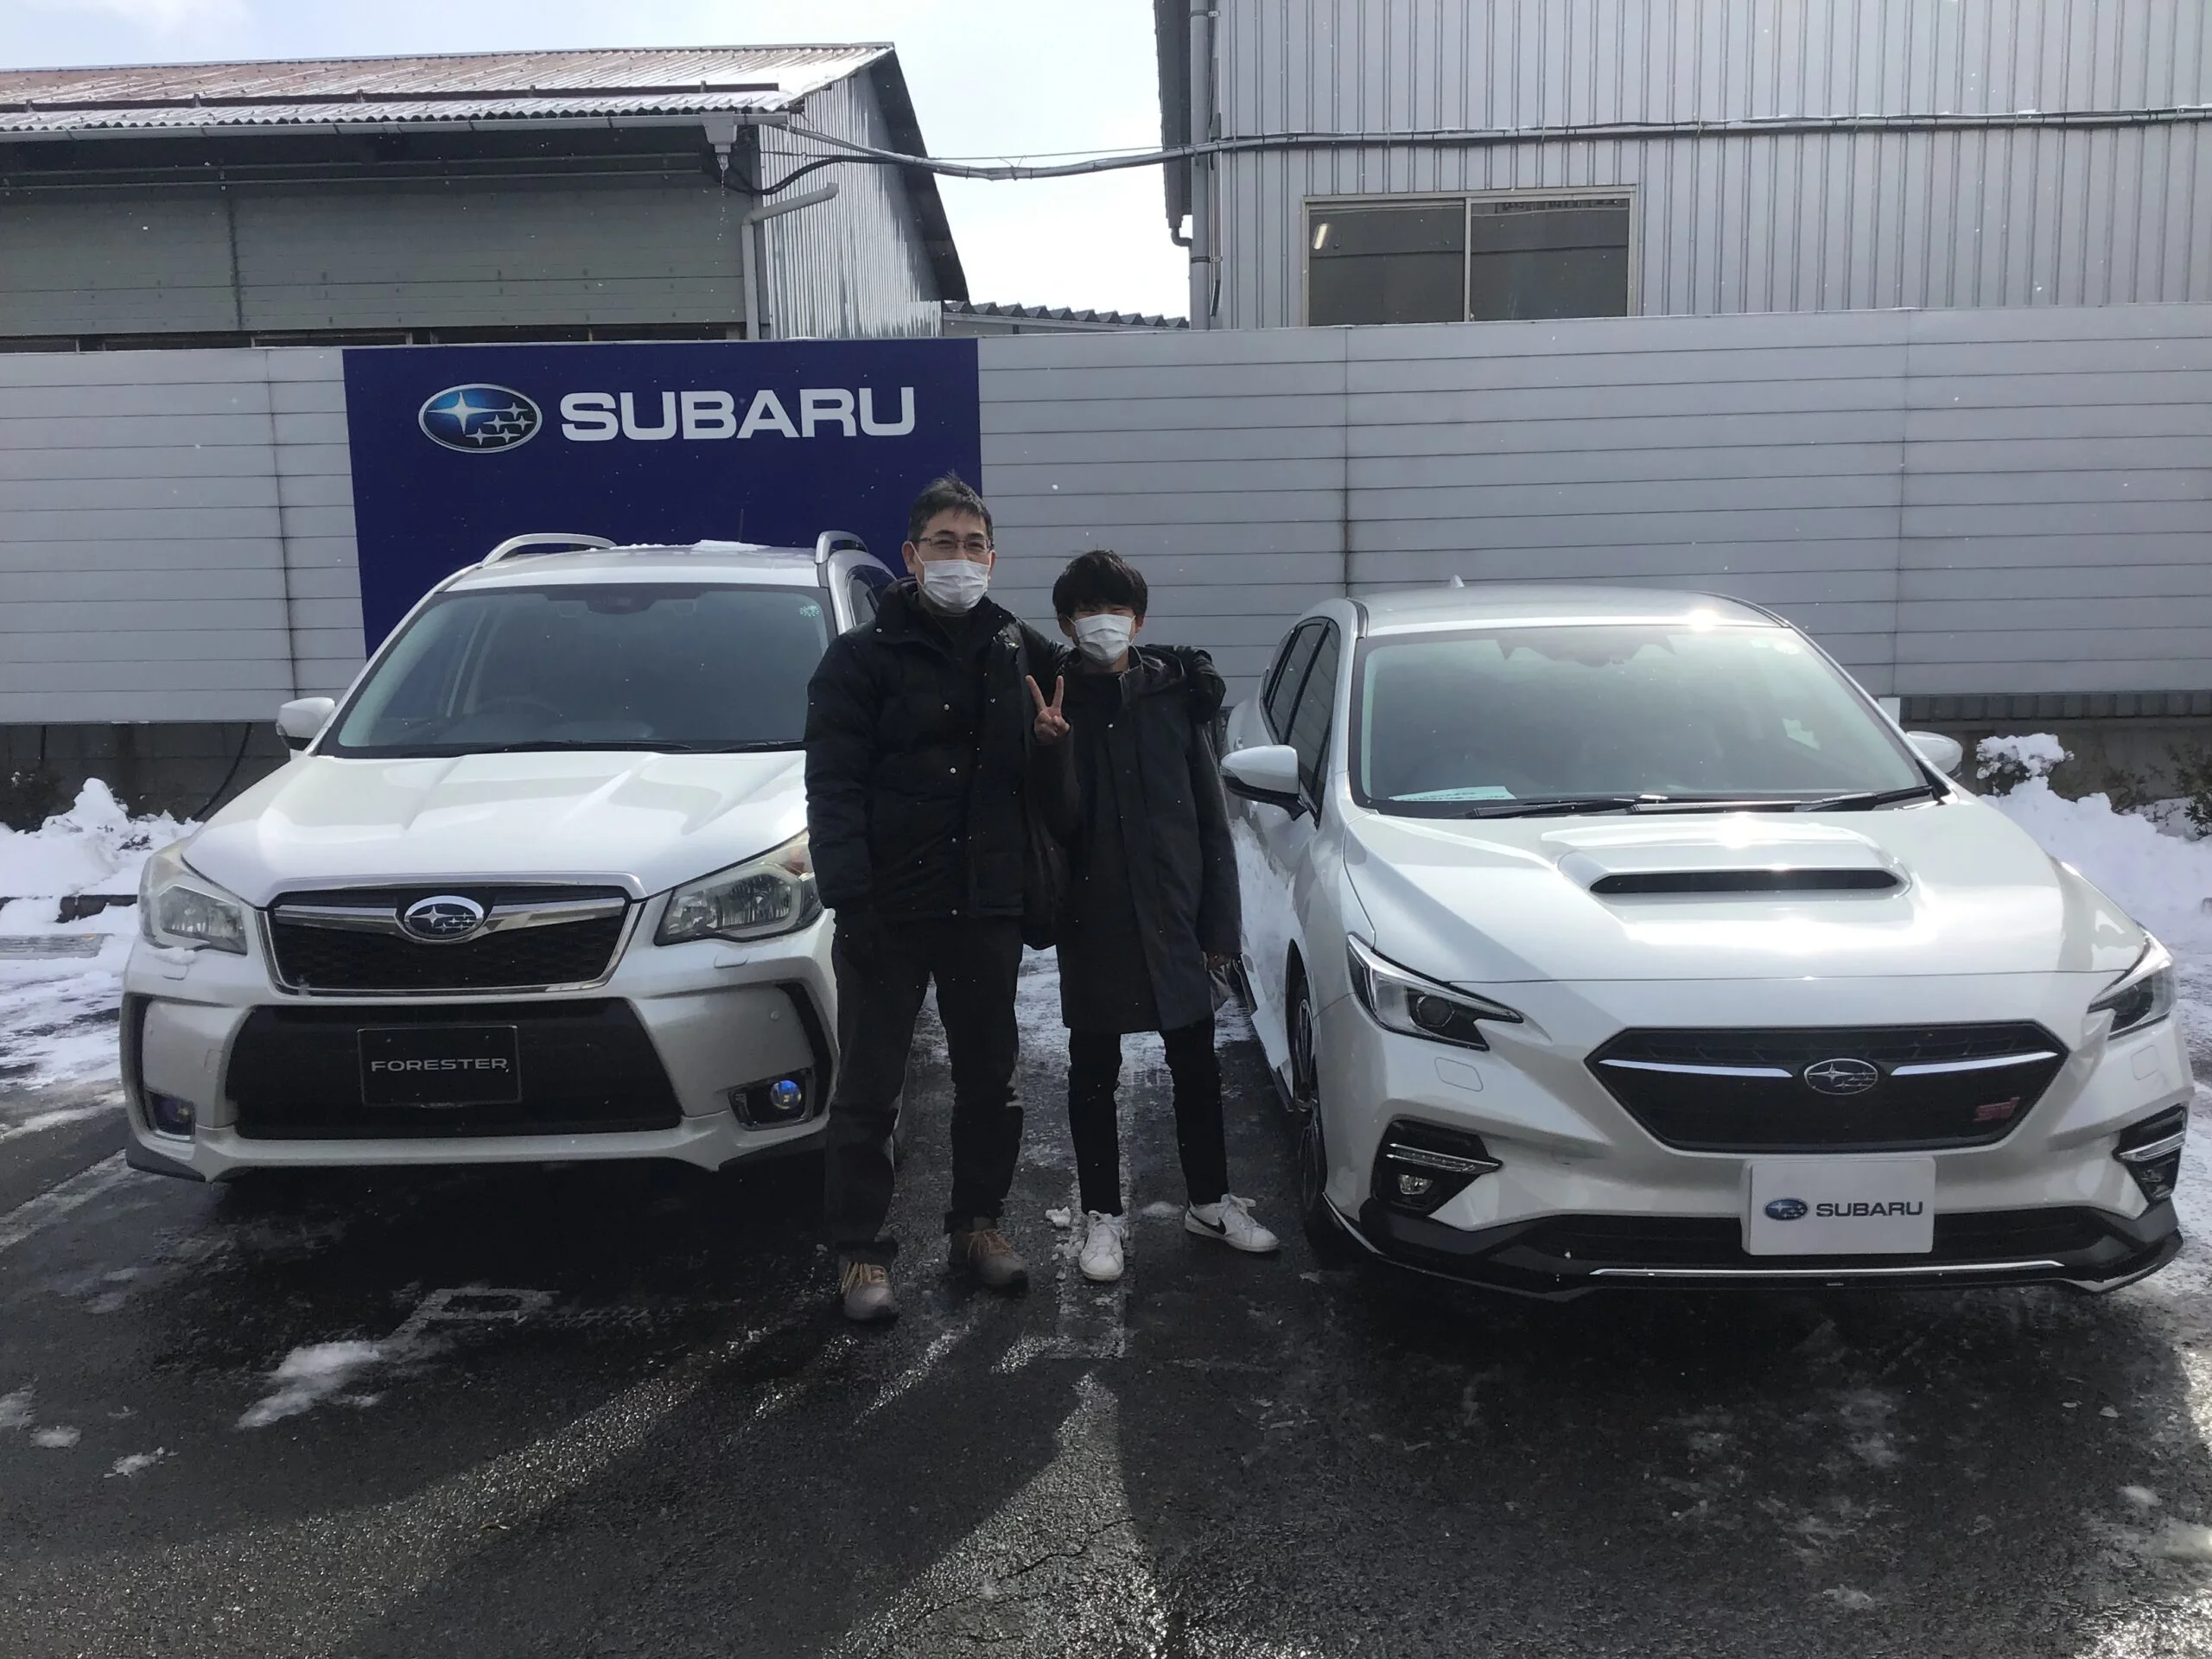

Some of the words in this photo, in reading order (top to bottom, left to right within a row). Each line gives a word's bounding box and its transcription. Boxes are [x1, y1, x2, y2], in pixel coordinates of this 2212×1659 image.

[560, 386, 915, 442] SUBARU
[371, 1058, 508, 1072] FORESTER
[1816, 1201, 1923, 1217] SUBARU
